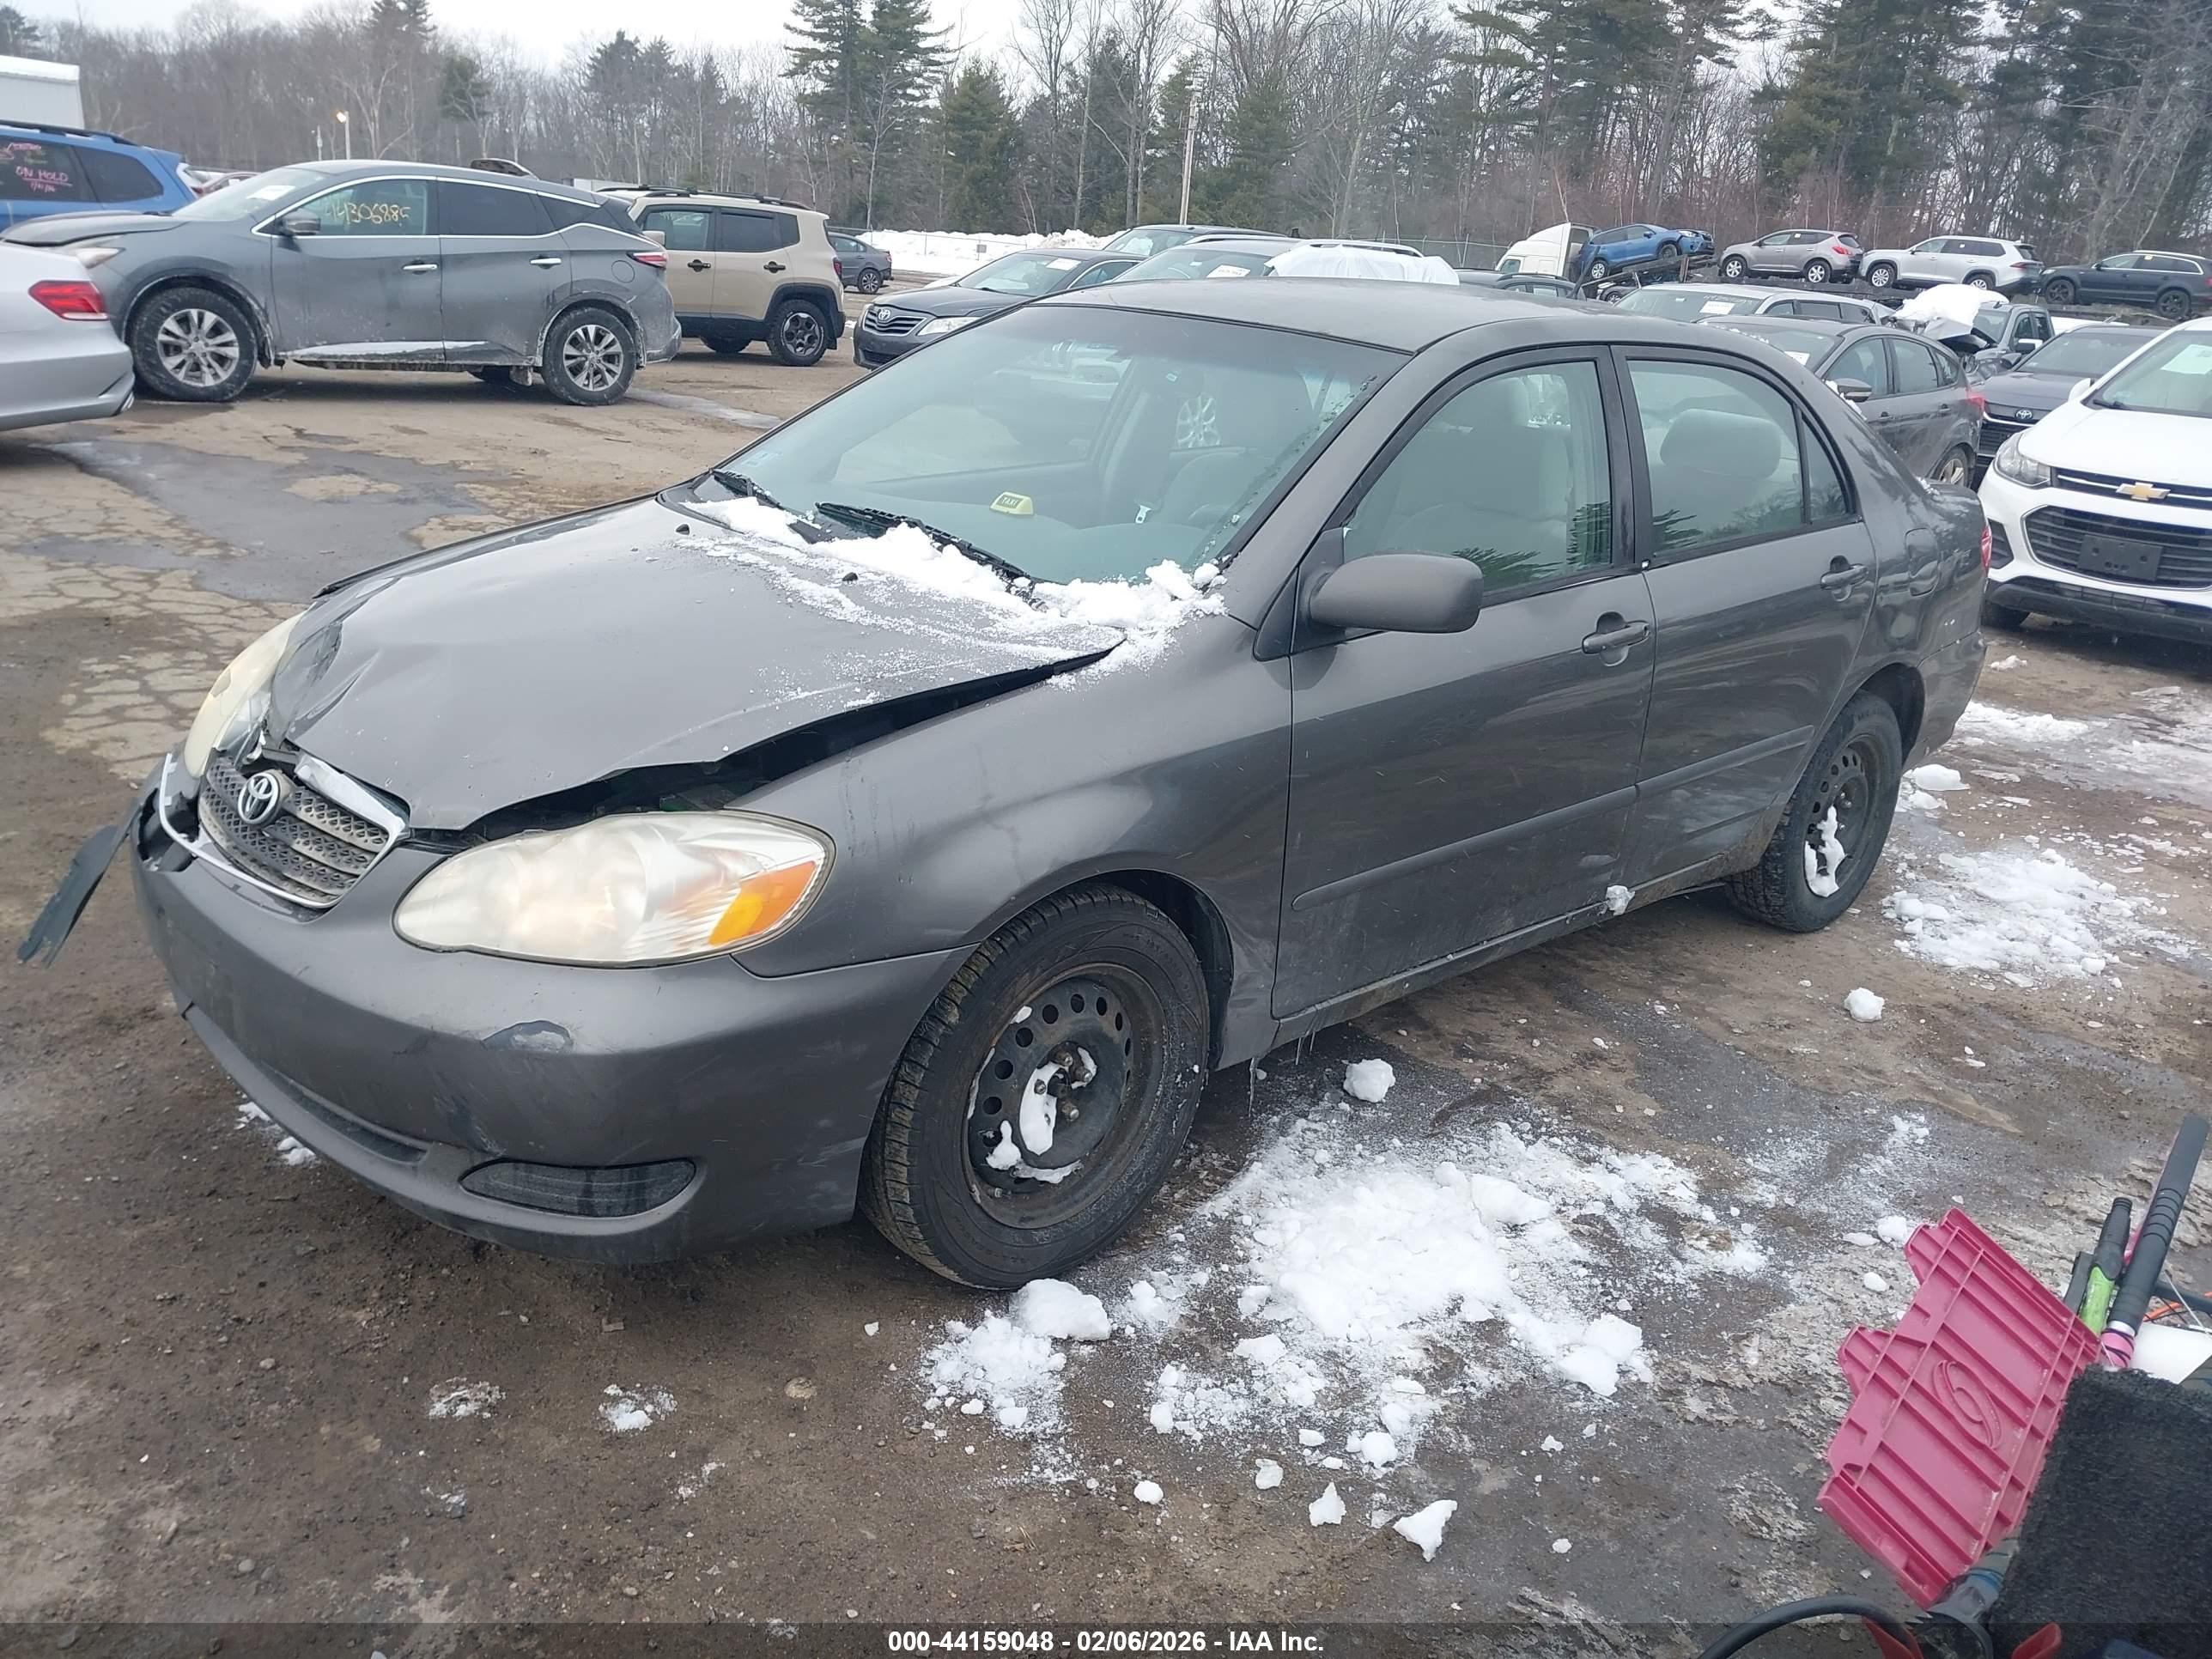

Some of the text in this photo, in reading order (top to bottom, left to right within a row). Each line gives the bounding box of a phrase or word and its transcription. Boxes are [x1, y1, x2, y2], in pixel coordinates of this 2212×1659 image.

[15, 166, 69, 182] ON HOLD
[1001, 495, 1018, 507] TAXI
